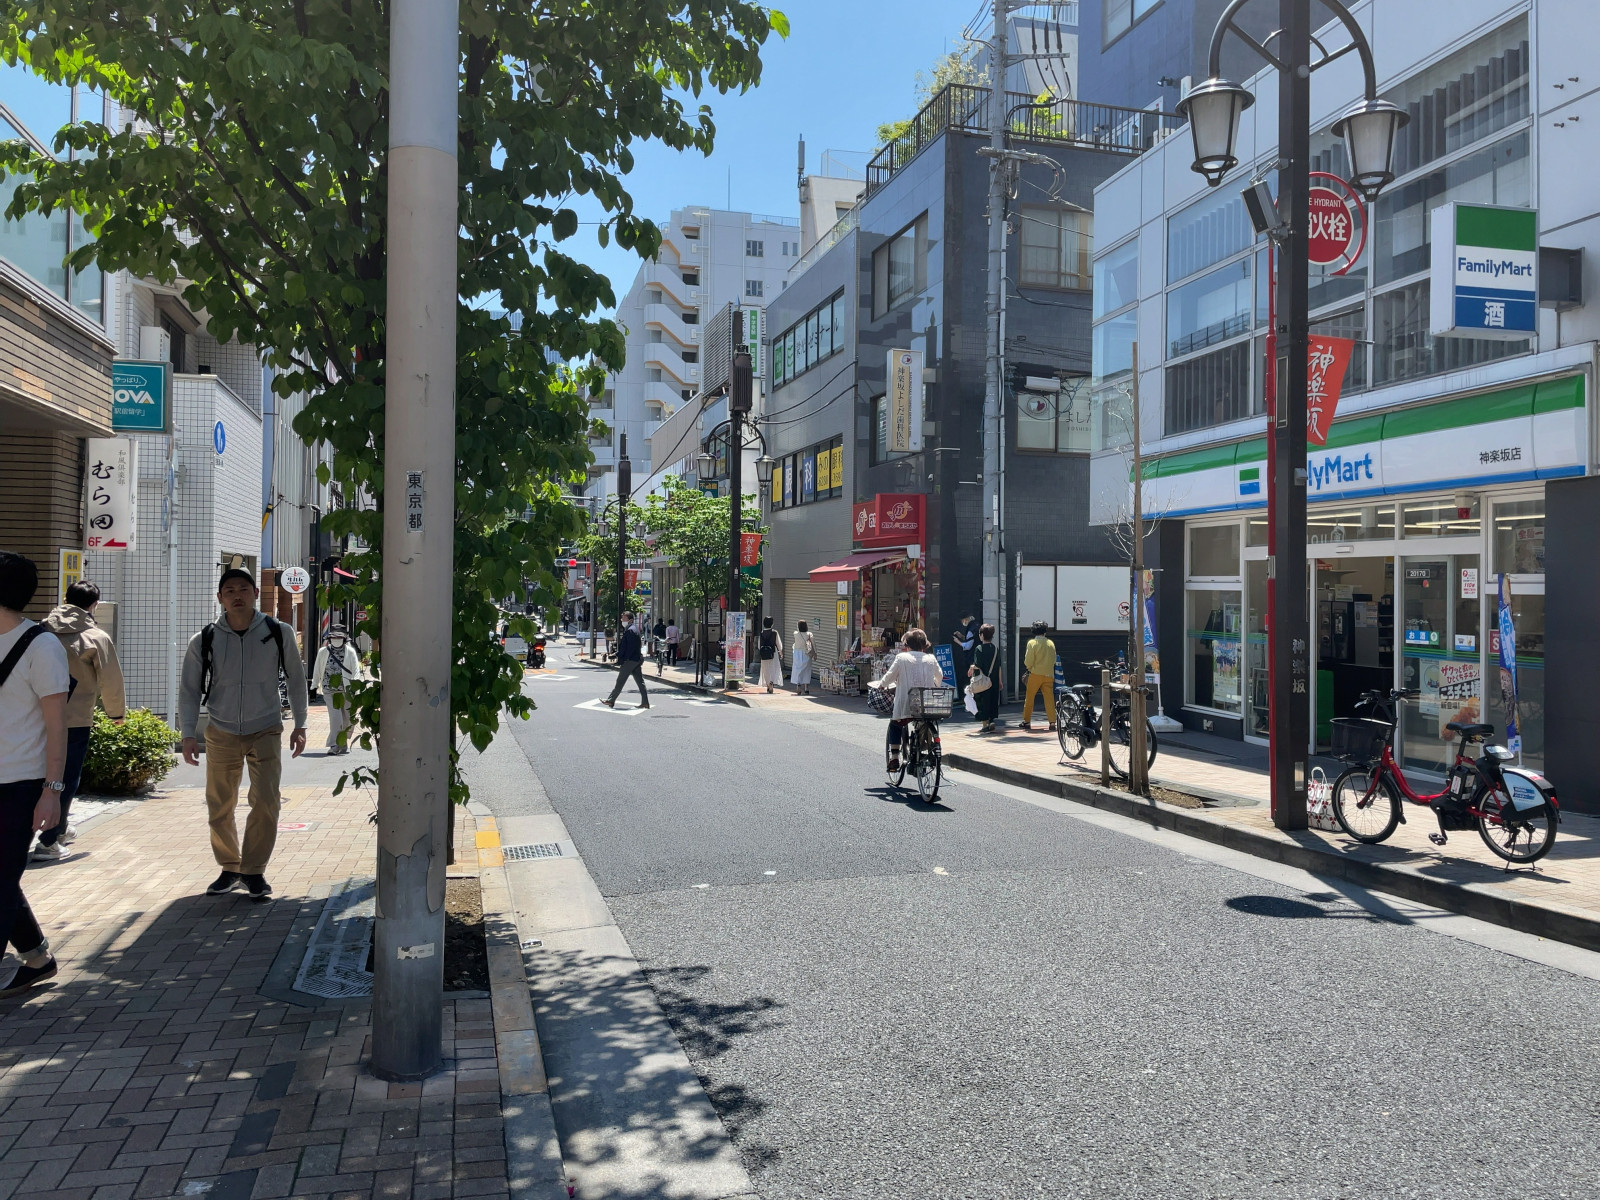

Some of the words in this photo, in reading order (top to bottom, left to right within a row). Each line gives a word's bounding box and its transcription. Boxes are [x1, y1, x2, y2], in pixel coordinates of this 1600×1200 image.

[1314, 198, 1341, 208] HYDRANT
[1309, 211, 1348, 242] 火栓
[1457, 256, 1533, 278] FamilyMart
[1483, 301, 1506, 328] 酒
[112, 388, 155, 404] OVA
[1479, 447, 1522, 465] 神楽坂店
[89, 459, 116, 531] むら田
[408, 473, 423, 529] 東京都
[87, 536, 102, 547] 6F
[1409, 570, 1427, 578] 20170
[1292, 638, 1306, 694] 神楽坂
